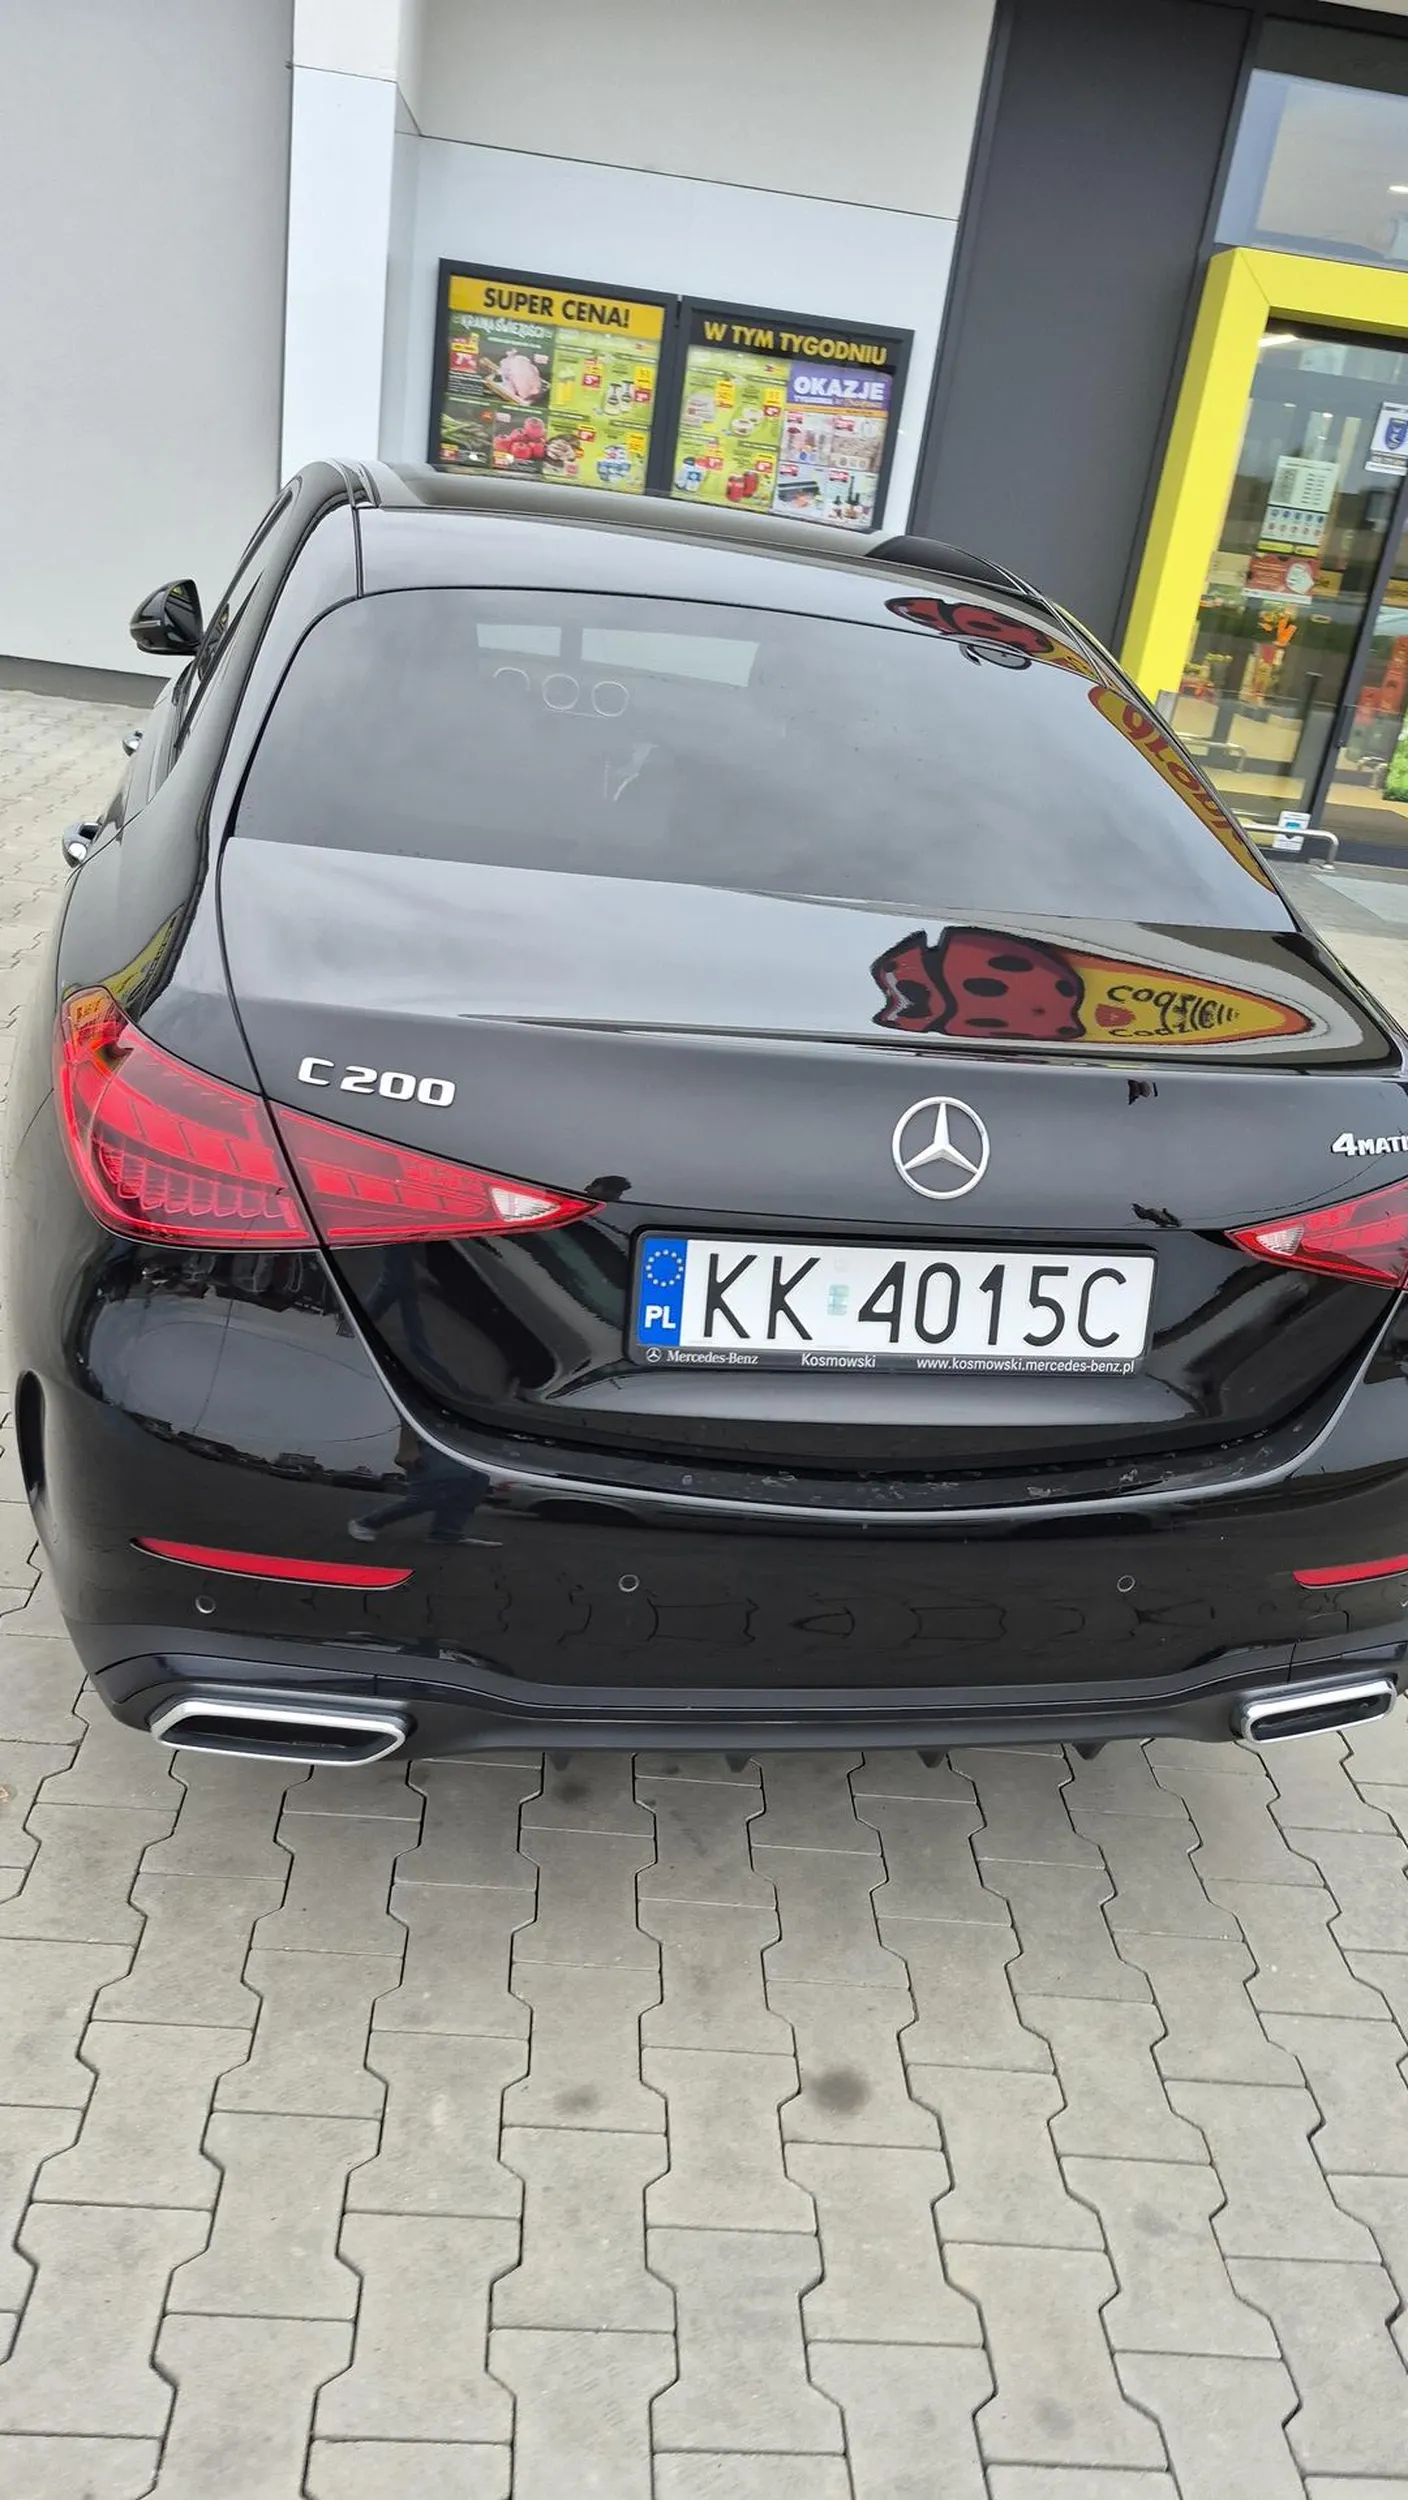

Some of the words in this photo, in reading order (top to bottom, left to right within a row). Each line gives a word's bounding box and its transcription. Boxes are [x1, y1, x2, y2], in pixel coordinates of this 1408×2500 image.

[483, 287, 554, 317] SUPER
[561, 300, 630, 328] CENA!
[703, 321, 728, 342] W
[731, 325, 774, 350] TYM
[779, 332, 887, 366] TYGODNIU
[793, 376, 885, 400] OKAZJE
[298, 1056, 335, 1087] C
[340, 1065, 456, 1108] 200
[1331, 1132, 1408, 1156] 4MATI
[703, 1253, 821, 1340] KK
[857, 1261, 1128, 1347] 4015C
[644, 1305, 676, 1329] PL
[667, 1350, 760, 1365] Mercedes-Benz
[801, 1353, 876, 1369] Kosmowski
[916, 1357, 1135, 1376] www.kosmowski.mercedes-benz.pl
